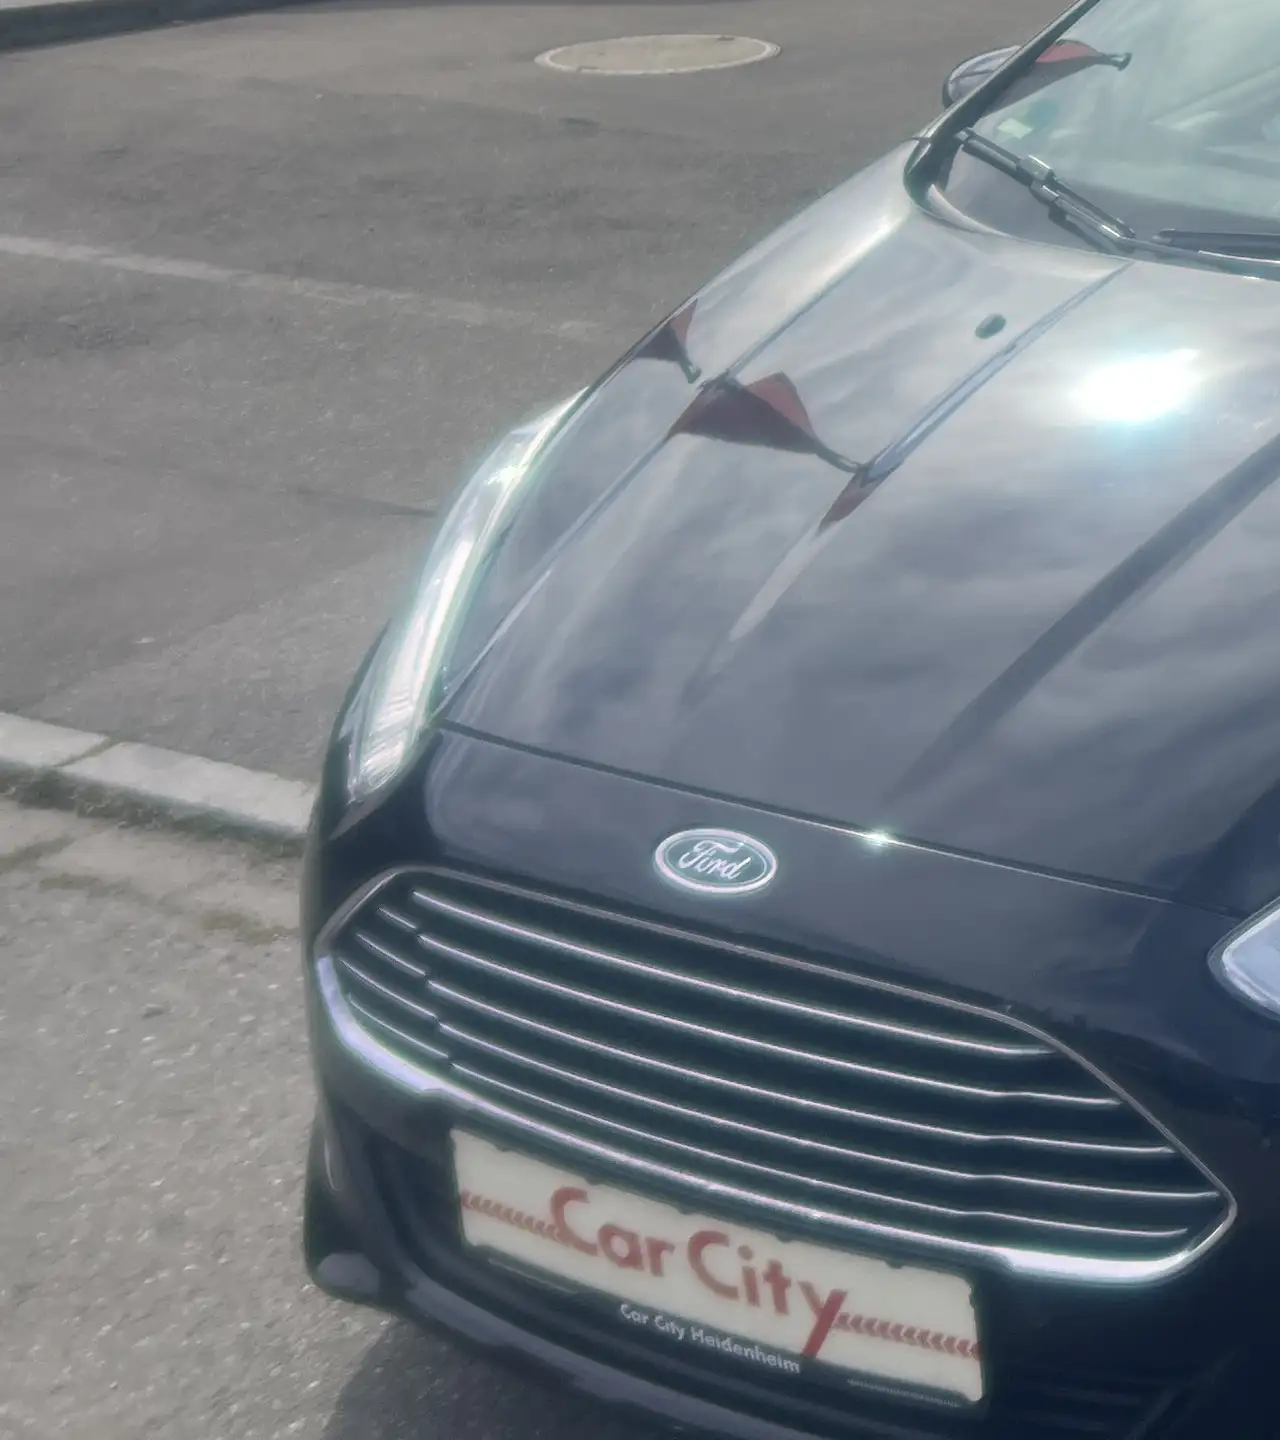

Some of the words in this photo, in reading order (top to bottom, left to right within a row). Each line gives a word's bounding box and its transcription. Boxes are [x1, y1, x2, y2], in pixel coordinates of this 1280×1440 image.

[678, 839, 752, 880] Ford
[620, 1303, 650, 1327] Car
[654, 1315, 687, 1341] City
[690, 1326, 800, 1375] Heidenheim
